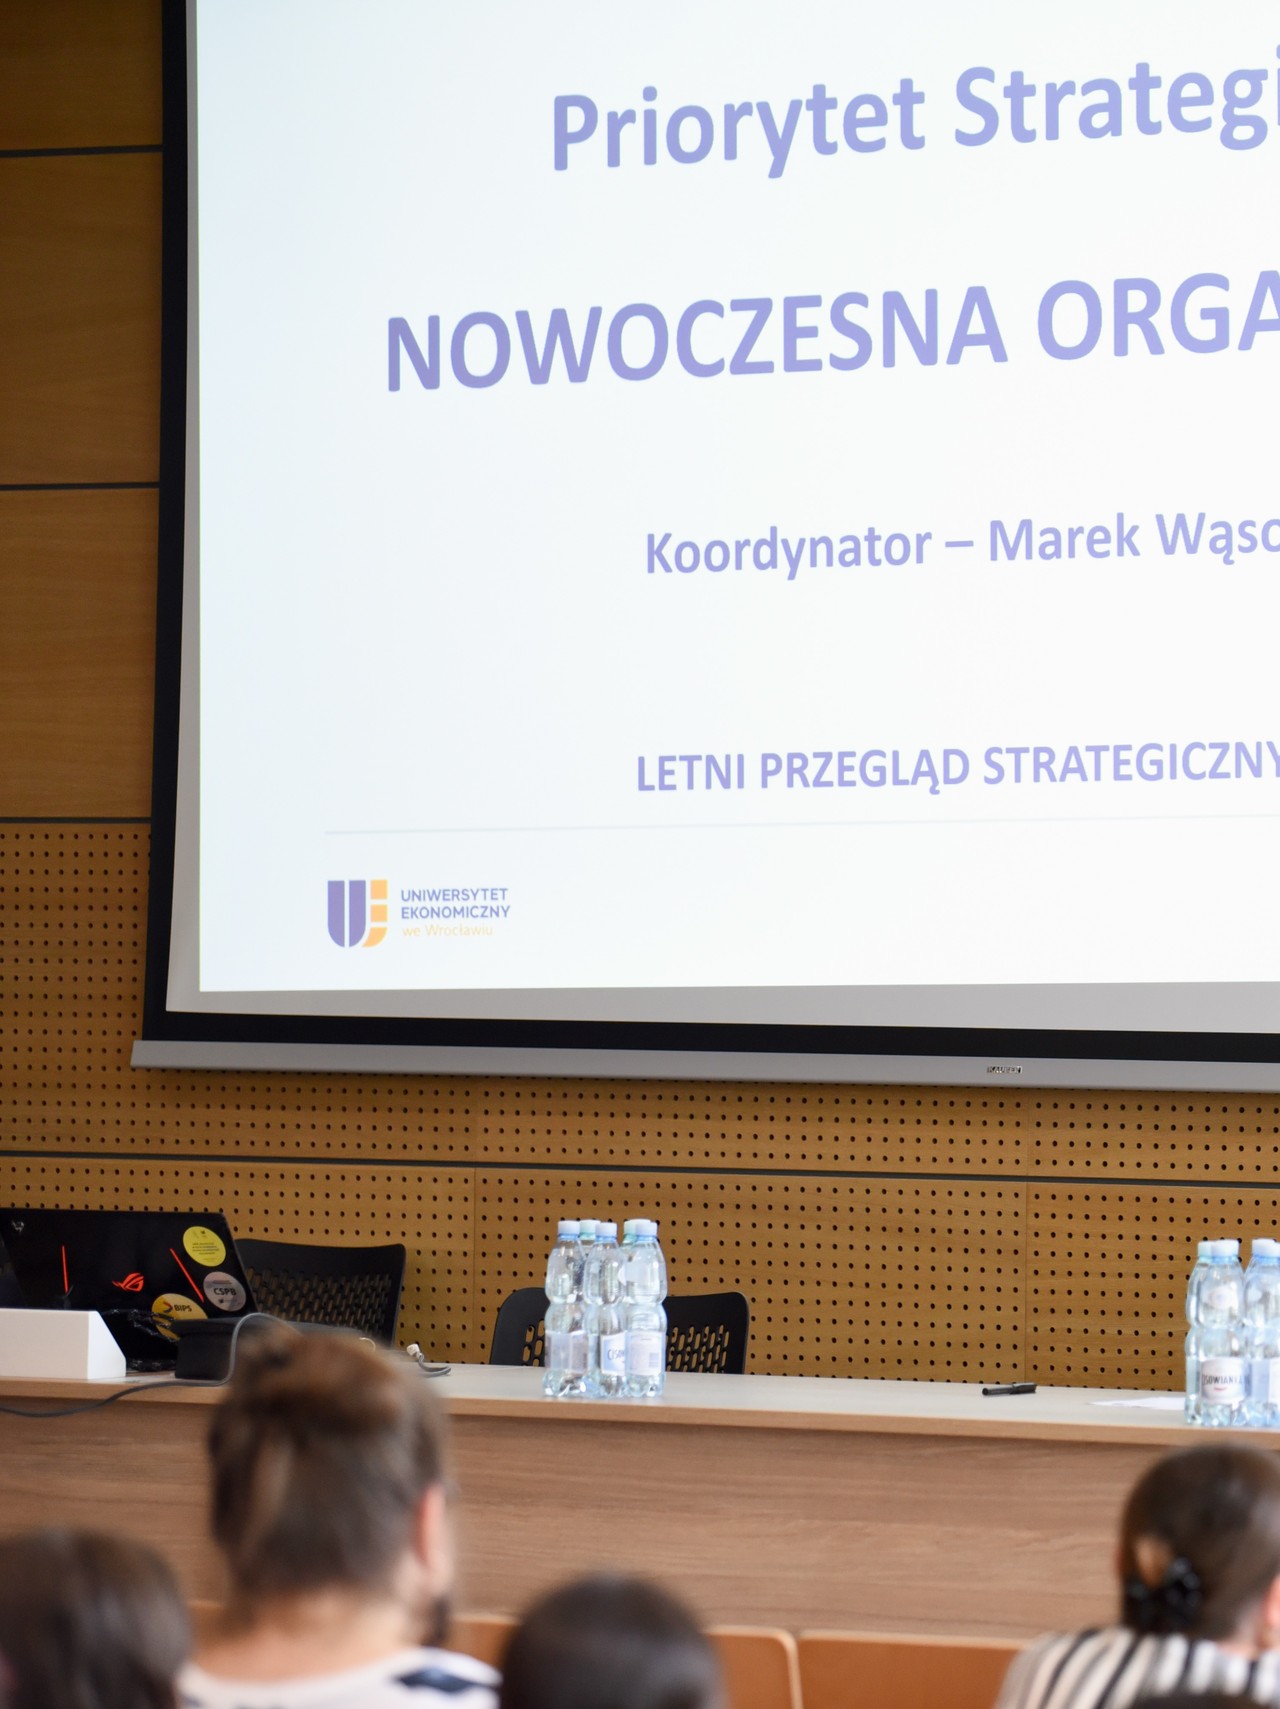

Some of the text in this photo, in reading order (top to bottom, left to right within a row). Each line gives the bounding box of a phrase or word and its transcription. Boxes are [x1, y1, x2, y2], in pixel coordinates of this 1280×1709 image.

[553, 77, 926, 180] Priorytet
[387, 285, 1009, 393] NOWOCZESNA
[647, 525, 933, 581] Koordynator
[990, 512, 1141, 562] Marek
[637, 753, 745, 792] LETNI
[761, 748, 970, 796] PRZEGLĄD
[401, 888, 509, 902] UNIWERSYTET
[401, 905, 511, 919] EKONOMICZNY
[402, 923, 493, 937] we Wrocławiu
[213, 1287, 237, 1296] CSPB
[174, 1304, 193, 1312] BIPS
